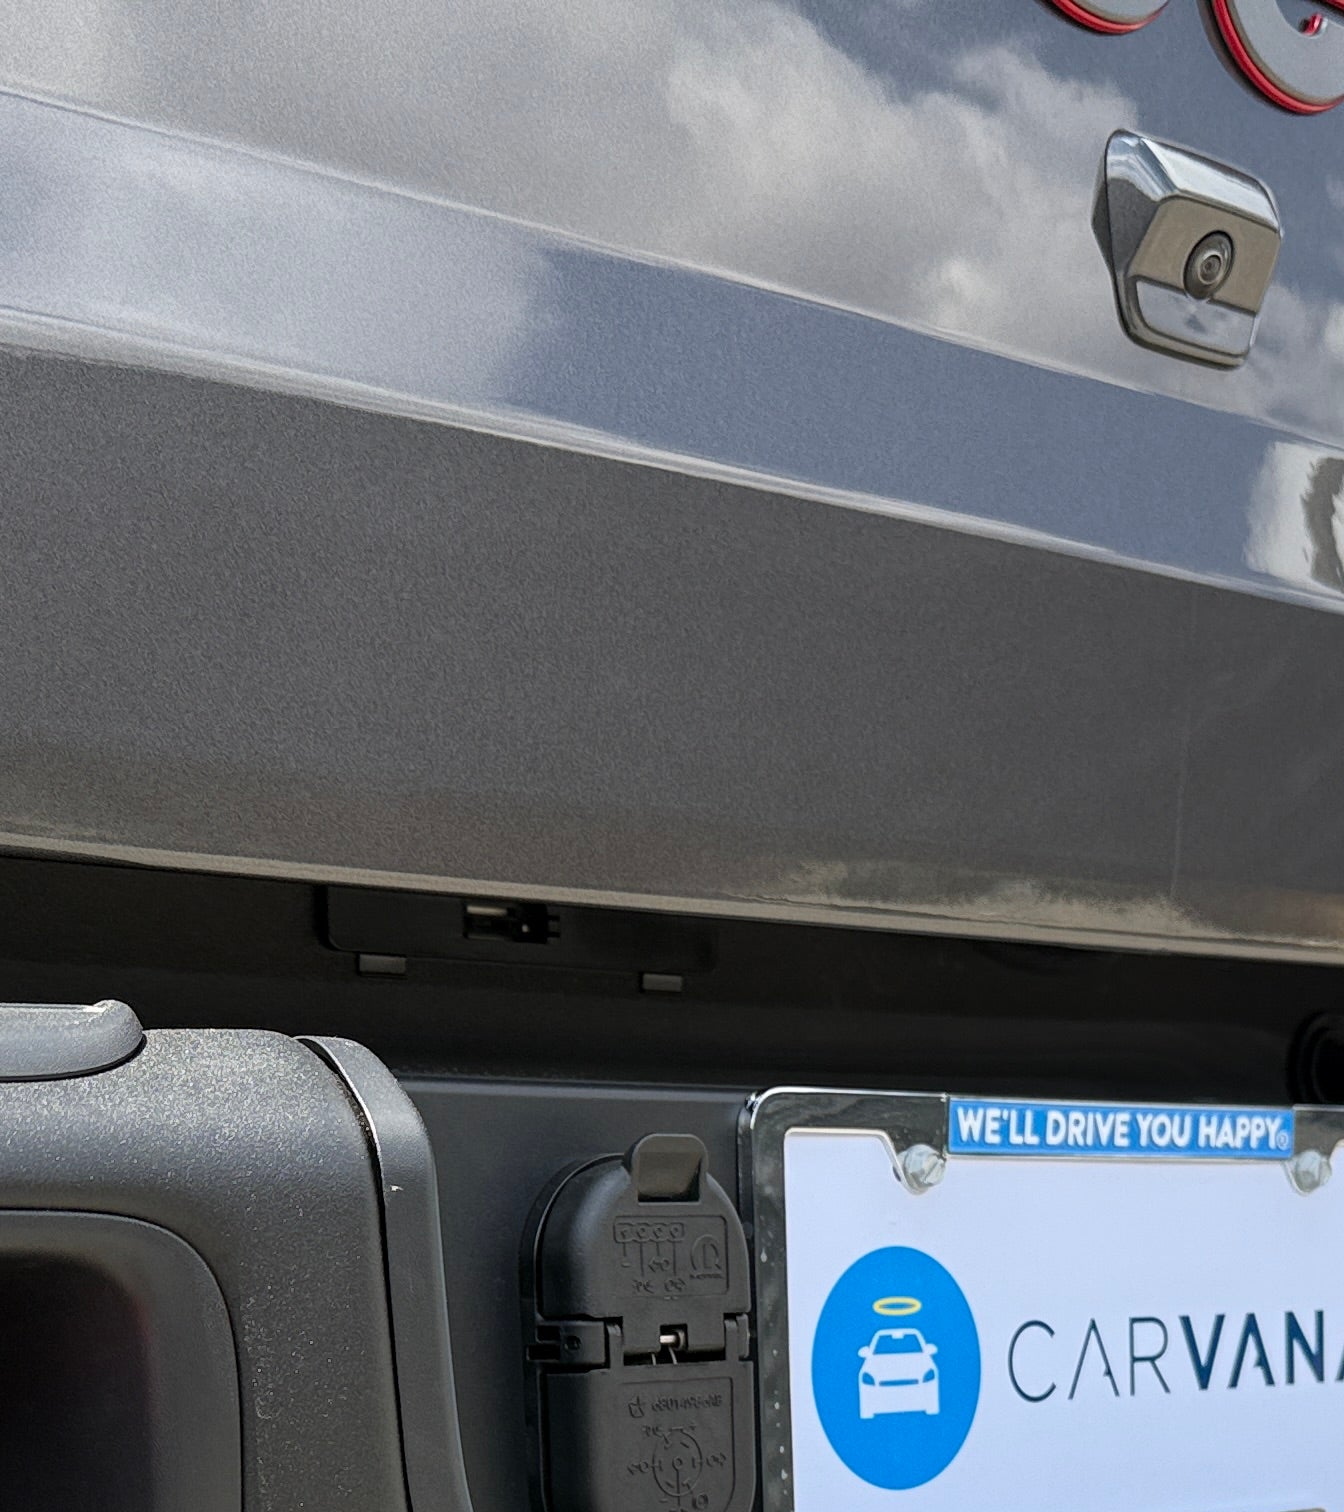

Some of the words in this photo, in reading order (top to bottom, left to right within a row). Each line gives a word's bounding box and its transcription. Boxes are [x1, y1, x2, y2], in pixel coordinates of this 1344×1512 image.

[956, 1106, 1039, 1146] WE'LL
[1045, 1109, 1130, 1148] DRIVE
[1135, 1112, 1191, 1148] YOU
